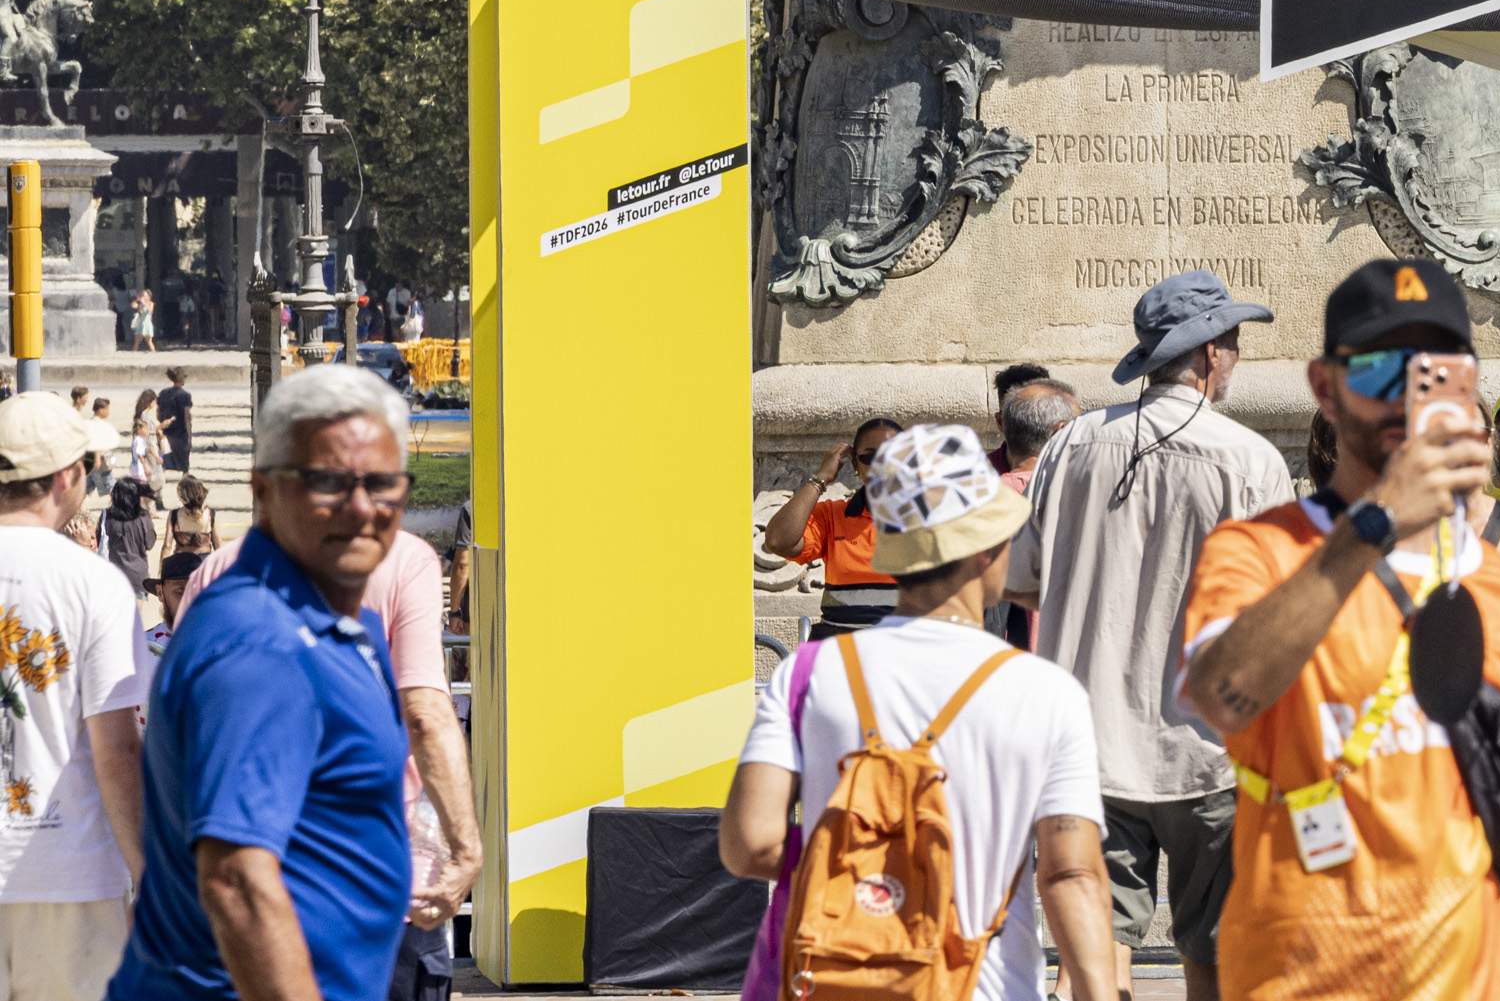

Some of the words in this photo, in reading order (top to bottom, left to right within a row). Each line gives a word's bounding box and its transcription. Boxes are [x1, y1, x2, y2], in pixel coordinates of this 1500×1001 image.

[1104, 74, 1133, 102] LA
[1143, 73, 1241, 102] PRIMERA
[1035, 134, 1165, 164] EXPOSICION
[1176, 134, 1297, 164] UNIVERSAL
[617, 174, 671, 203] letour.fr
[679, 153, 735, 183] @LeTour
[550, 217, 608, 248] #TDF2026
[616, 184, 711, 225] #TourDeFrance
[1012, 197, 1144, 226] CELEBRADA
[1153, 197, 1181, 226] EN
[1193, 195, 1326, 226] BARCELONA
